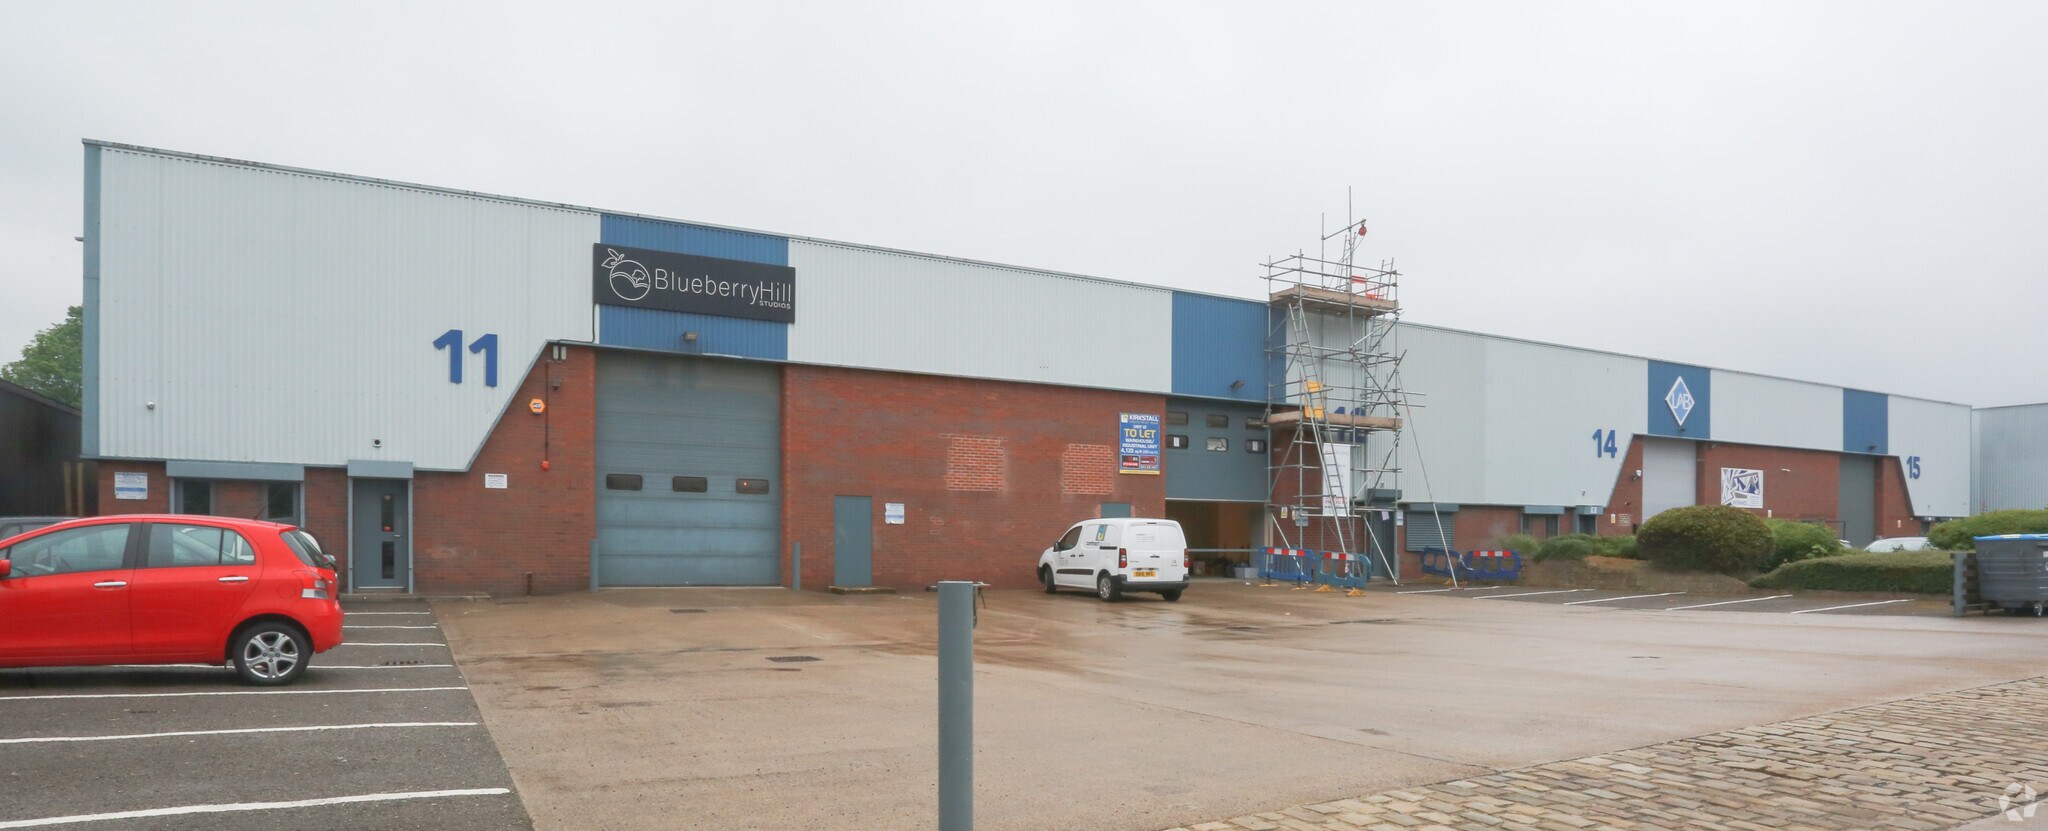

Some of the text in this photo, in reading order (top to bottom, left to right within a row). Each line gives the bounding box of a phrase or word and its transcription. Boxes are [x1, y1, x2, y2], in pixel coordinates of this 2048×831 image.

[759, 300, 791, 309] STUDIOS
[432, 329, 498, 388] 11
[1671, 393, 1691, 410] LAB
[1124, 428, 1156, 438] TO LET
[1592, 429, 1617, 458] 14
[1906, 456, 1921, 480] 15
